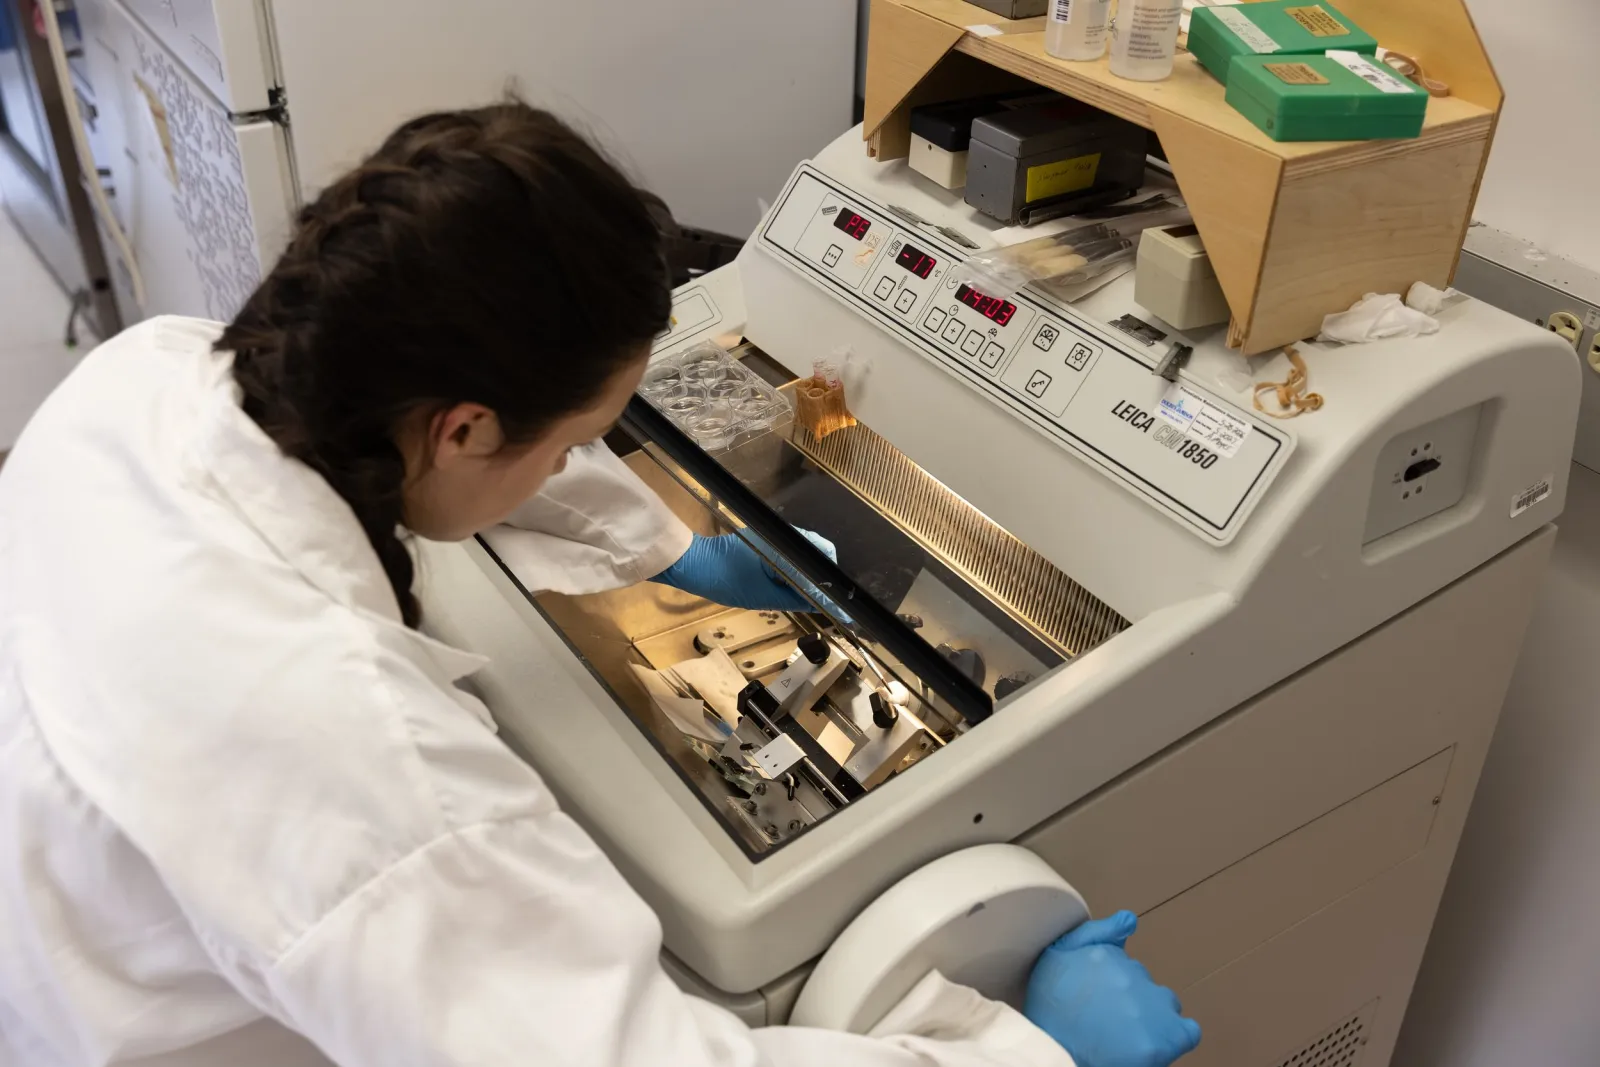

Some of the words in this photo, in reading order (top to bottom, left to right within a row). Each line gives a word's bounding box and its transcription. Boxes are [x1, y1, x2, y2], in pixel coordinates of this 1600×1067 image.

[846, 215, 870, 239] PE
[902, 253, 936, 278] -17
[961, 286, 1017, 325] 14:03
[1111, 400, 1155, 433] LEICA
